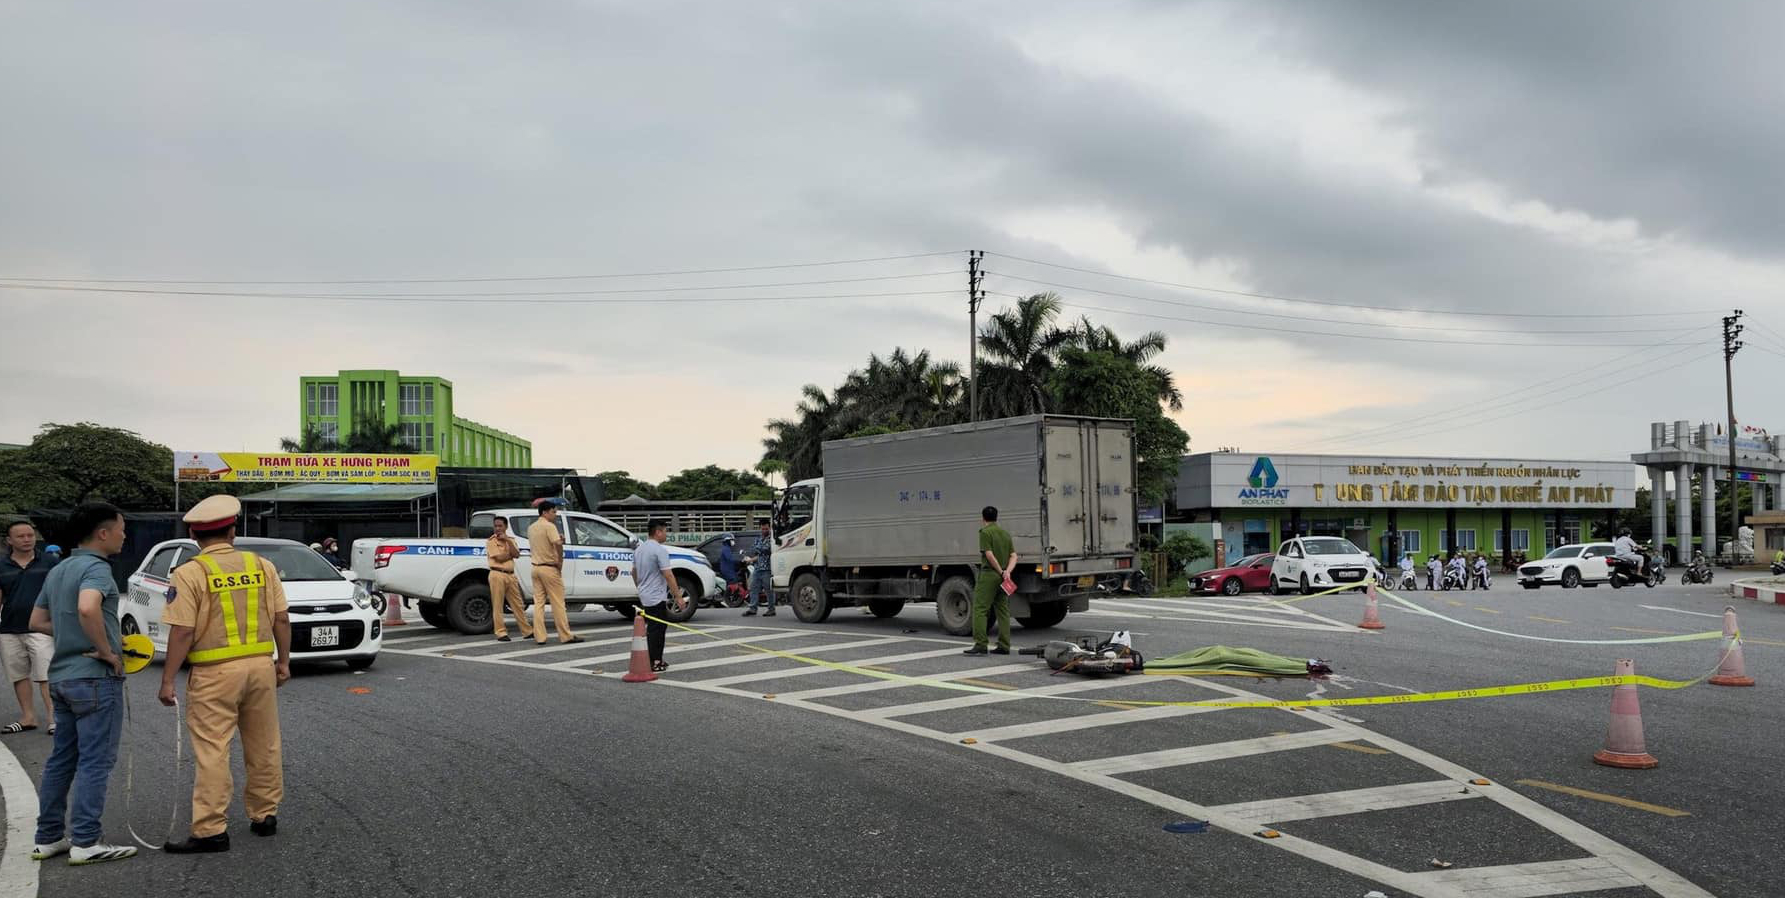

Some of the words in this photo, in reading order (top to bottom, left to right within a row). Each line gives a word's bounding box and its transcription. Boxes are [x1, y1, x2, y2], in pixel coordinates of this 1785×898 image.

[258, 457, 291, 468] TRẠM
[322, 457, 337, 467] XE
[341, 457, 373, 467] HƯNG
[376, 457, 410, 469] PHẠM
[1349, 465, 1371, 475] BAN
[1399, 465, 1419, 478] TẠO
[1379, 480, 1419, 502] TÂM
[1463, 485, 1496, 506] TẠO
[1547, 486, 1571, 503] AN
[1574, 482, 1615, 503] PHÁT
[213, 573, 262, 589] C.S.G.T
[317, 628, 333, 637] 34A
